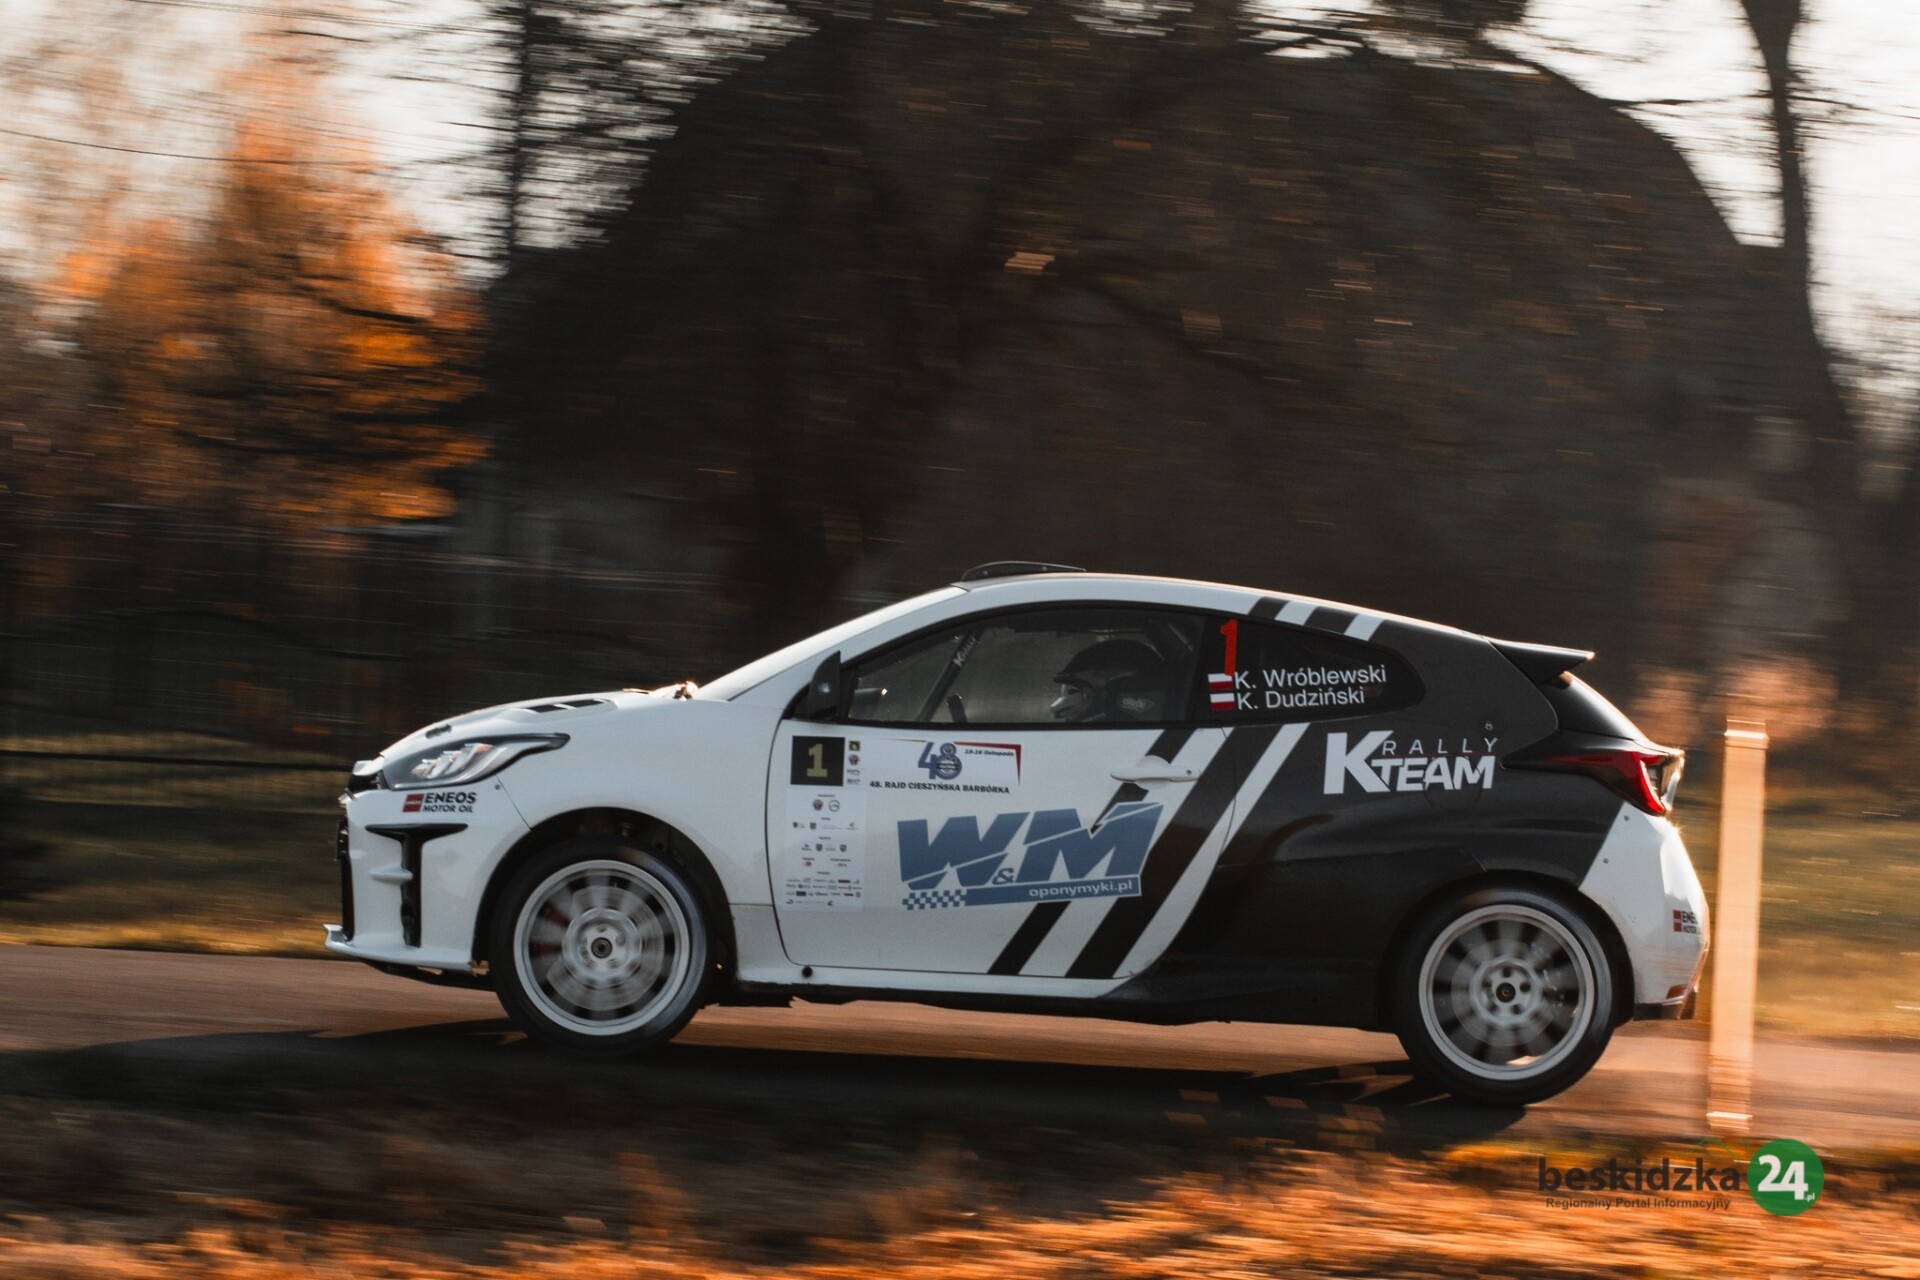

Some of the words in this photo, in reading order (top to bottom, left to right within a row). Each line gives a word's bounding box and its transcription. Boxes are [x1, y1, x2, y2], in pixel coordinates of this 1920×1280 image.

[1220, 619, 1238, 676] 1
[1234, 671, 1256, 690] K.
[1262, 664, 1387, 689] Wróblewski
[1237, 692, 1258, 711] K.
[1265, 686, 1365, 709] Dudziński
[1382, 737, 1498, 756] RALLY
[806, 743, 828, 778] 1
[1323, 730, 1394, 795] K
[1371, 755, 1495, 792] TEAM
[425, 791, 477, 804] ENEOS
[869, 780, 882, 789] 48.
[885, 780, 906, 790] RAJD
[908, 781, 960, 792] CIESZYŃSKA
[962, 783, 1010, 795] BARBÓRKA
[422, 804, 456, 813] MOTOR
[458, 804, 473, 813] OIL
[1028, 879, 1133, 899] oponymyki.pl
